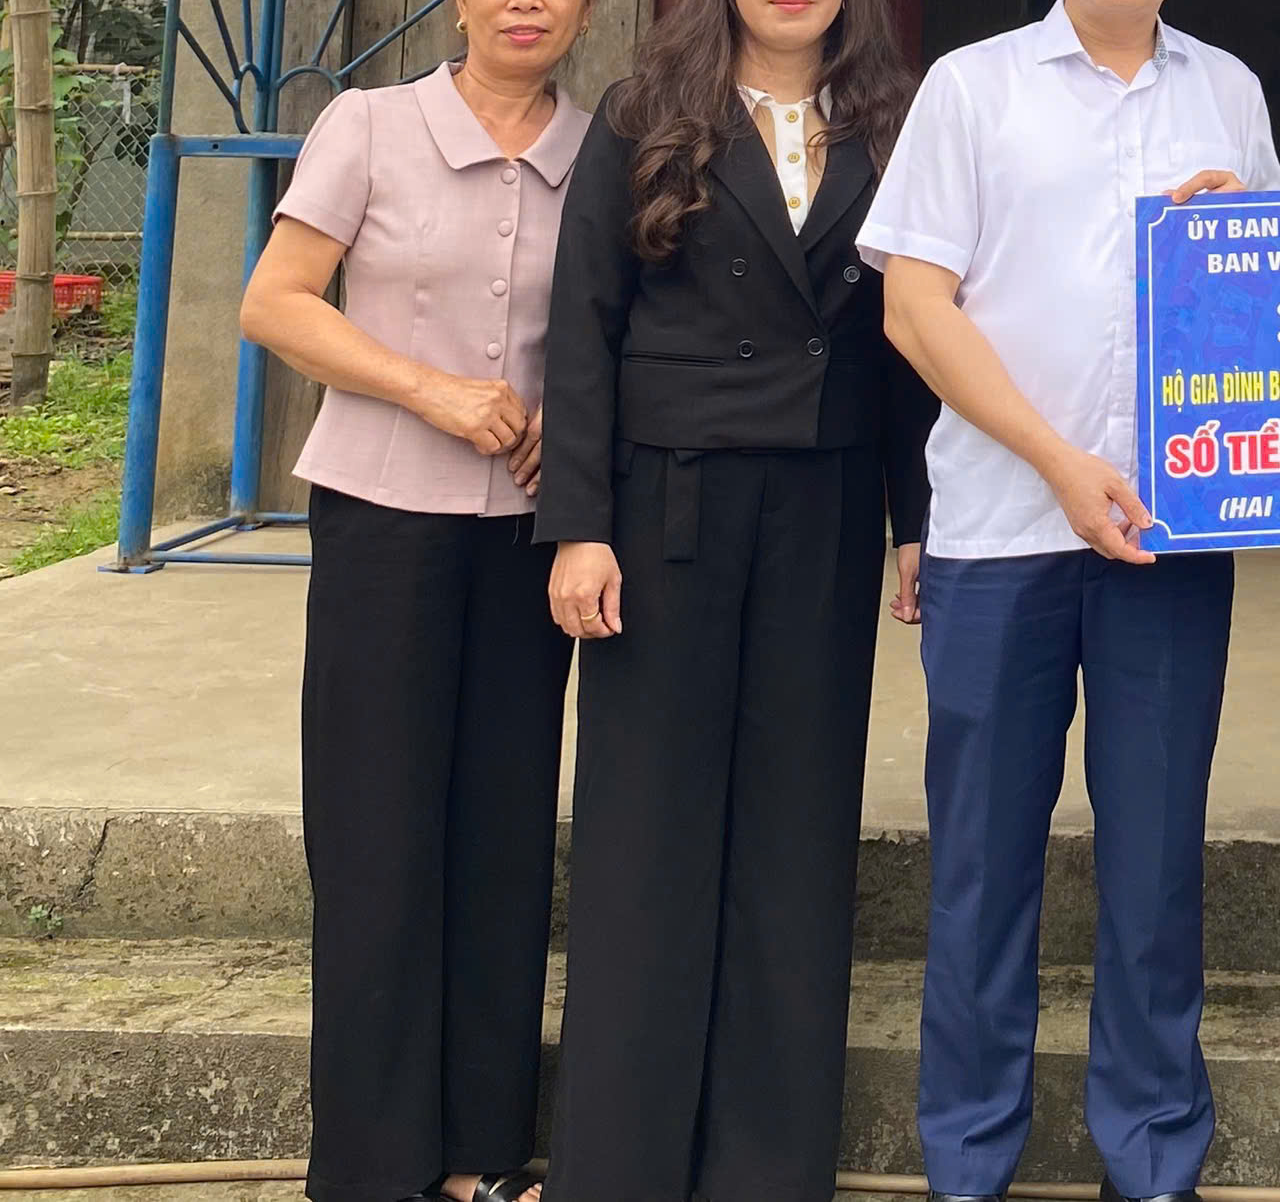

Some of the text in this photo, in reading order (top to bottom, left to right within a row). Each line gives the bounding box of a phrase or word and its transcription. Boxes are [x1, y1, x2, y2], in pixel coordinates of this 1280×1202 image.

[1188, 214, 1219, 240] ỦY
[1228, 217, 1278, 238] BAN
[1208, 252, 1259, 273] BAN
[1162, 369, 1185, 412] HỘ
[1190, 373, 1219, 404] GIA
[1223, 366, 1264, 403] ĐÌNH
[1166, 420, 1220, 478] SỐ
[1219, 496, 1273, 521] (HAI
